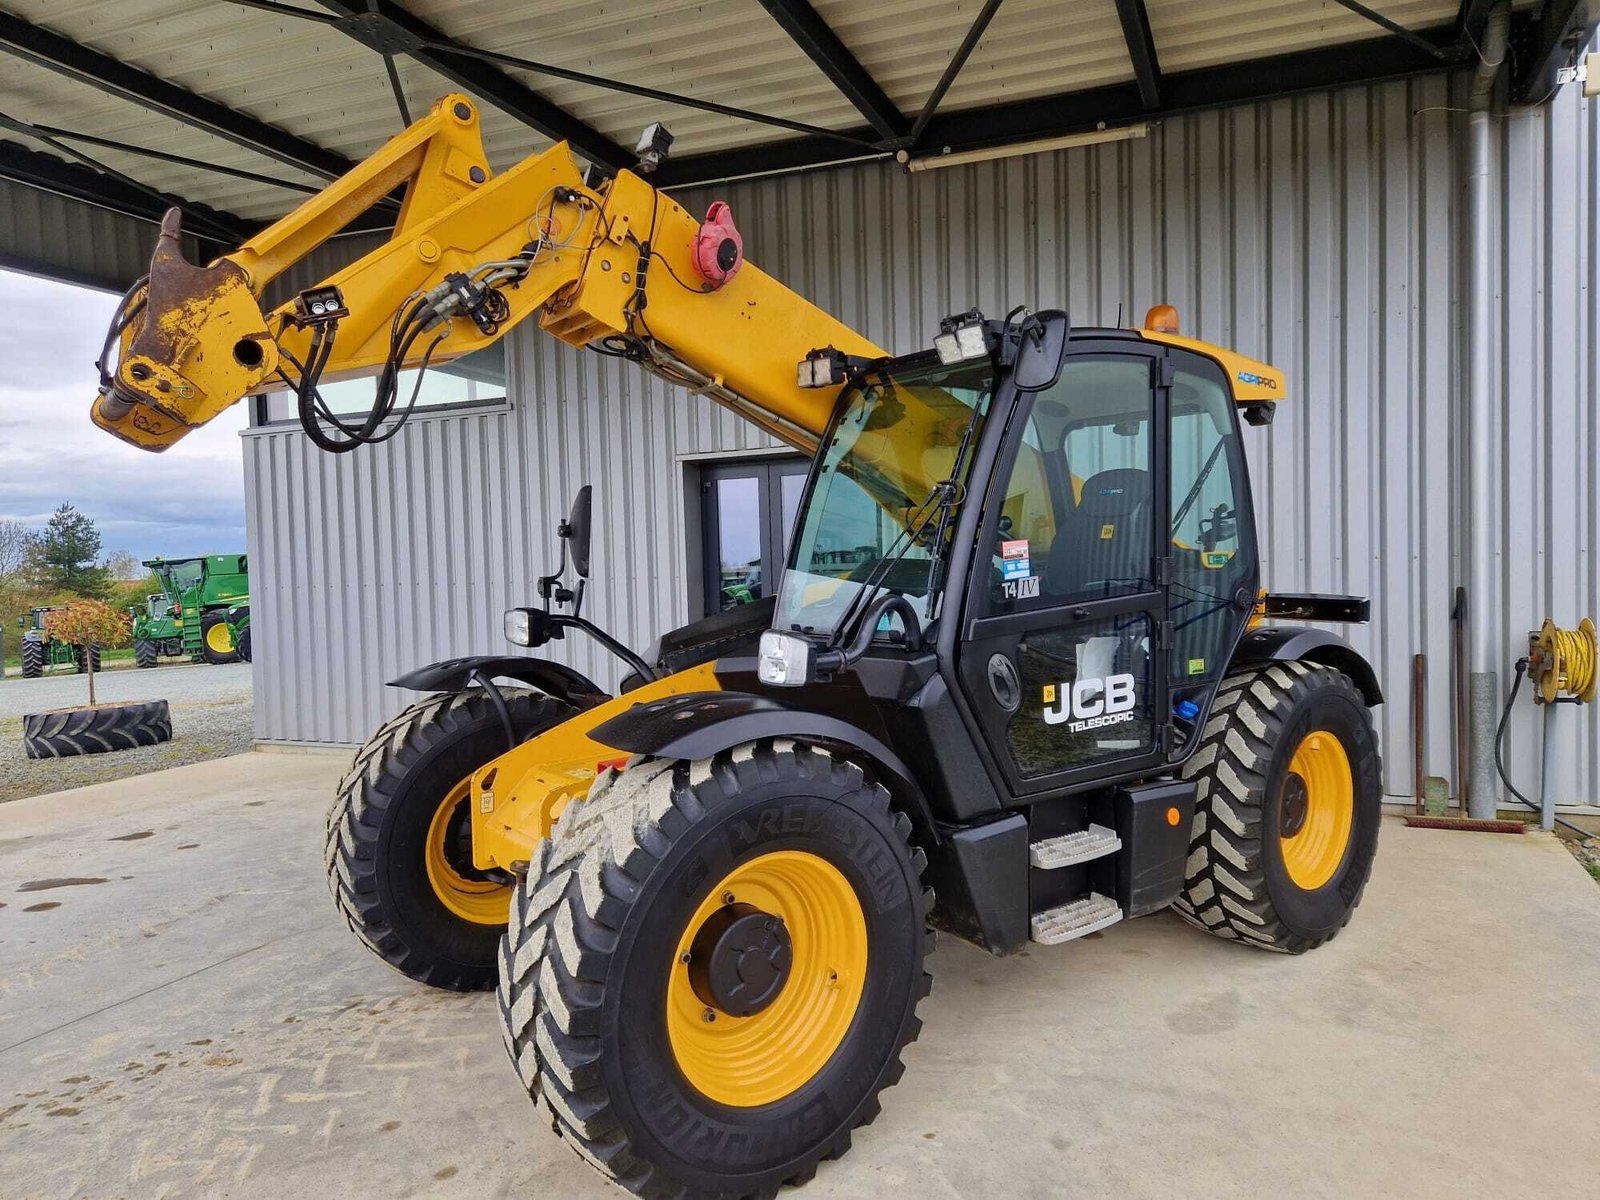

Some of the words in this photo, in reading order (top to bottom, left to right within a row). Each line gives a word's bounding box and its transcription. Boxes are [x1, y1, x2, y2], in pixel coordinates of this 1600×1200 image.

[1237, 371, 1277, 390] AGRIPRO
[1001, 581, 1017, 599] T4
[1043, 673, 1136, 725] JCB
[1068, 711, 1134, 733] TELESCOPIC
